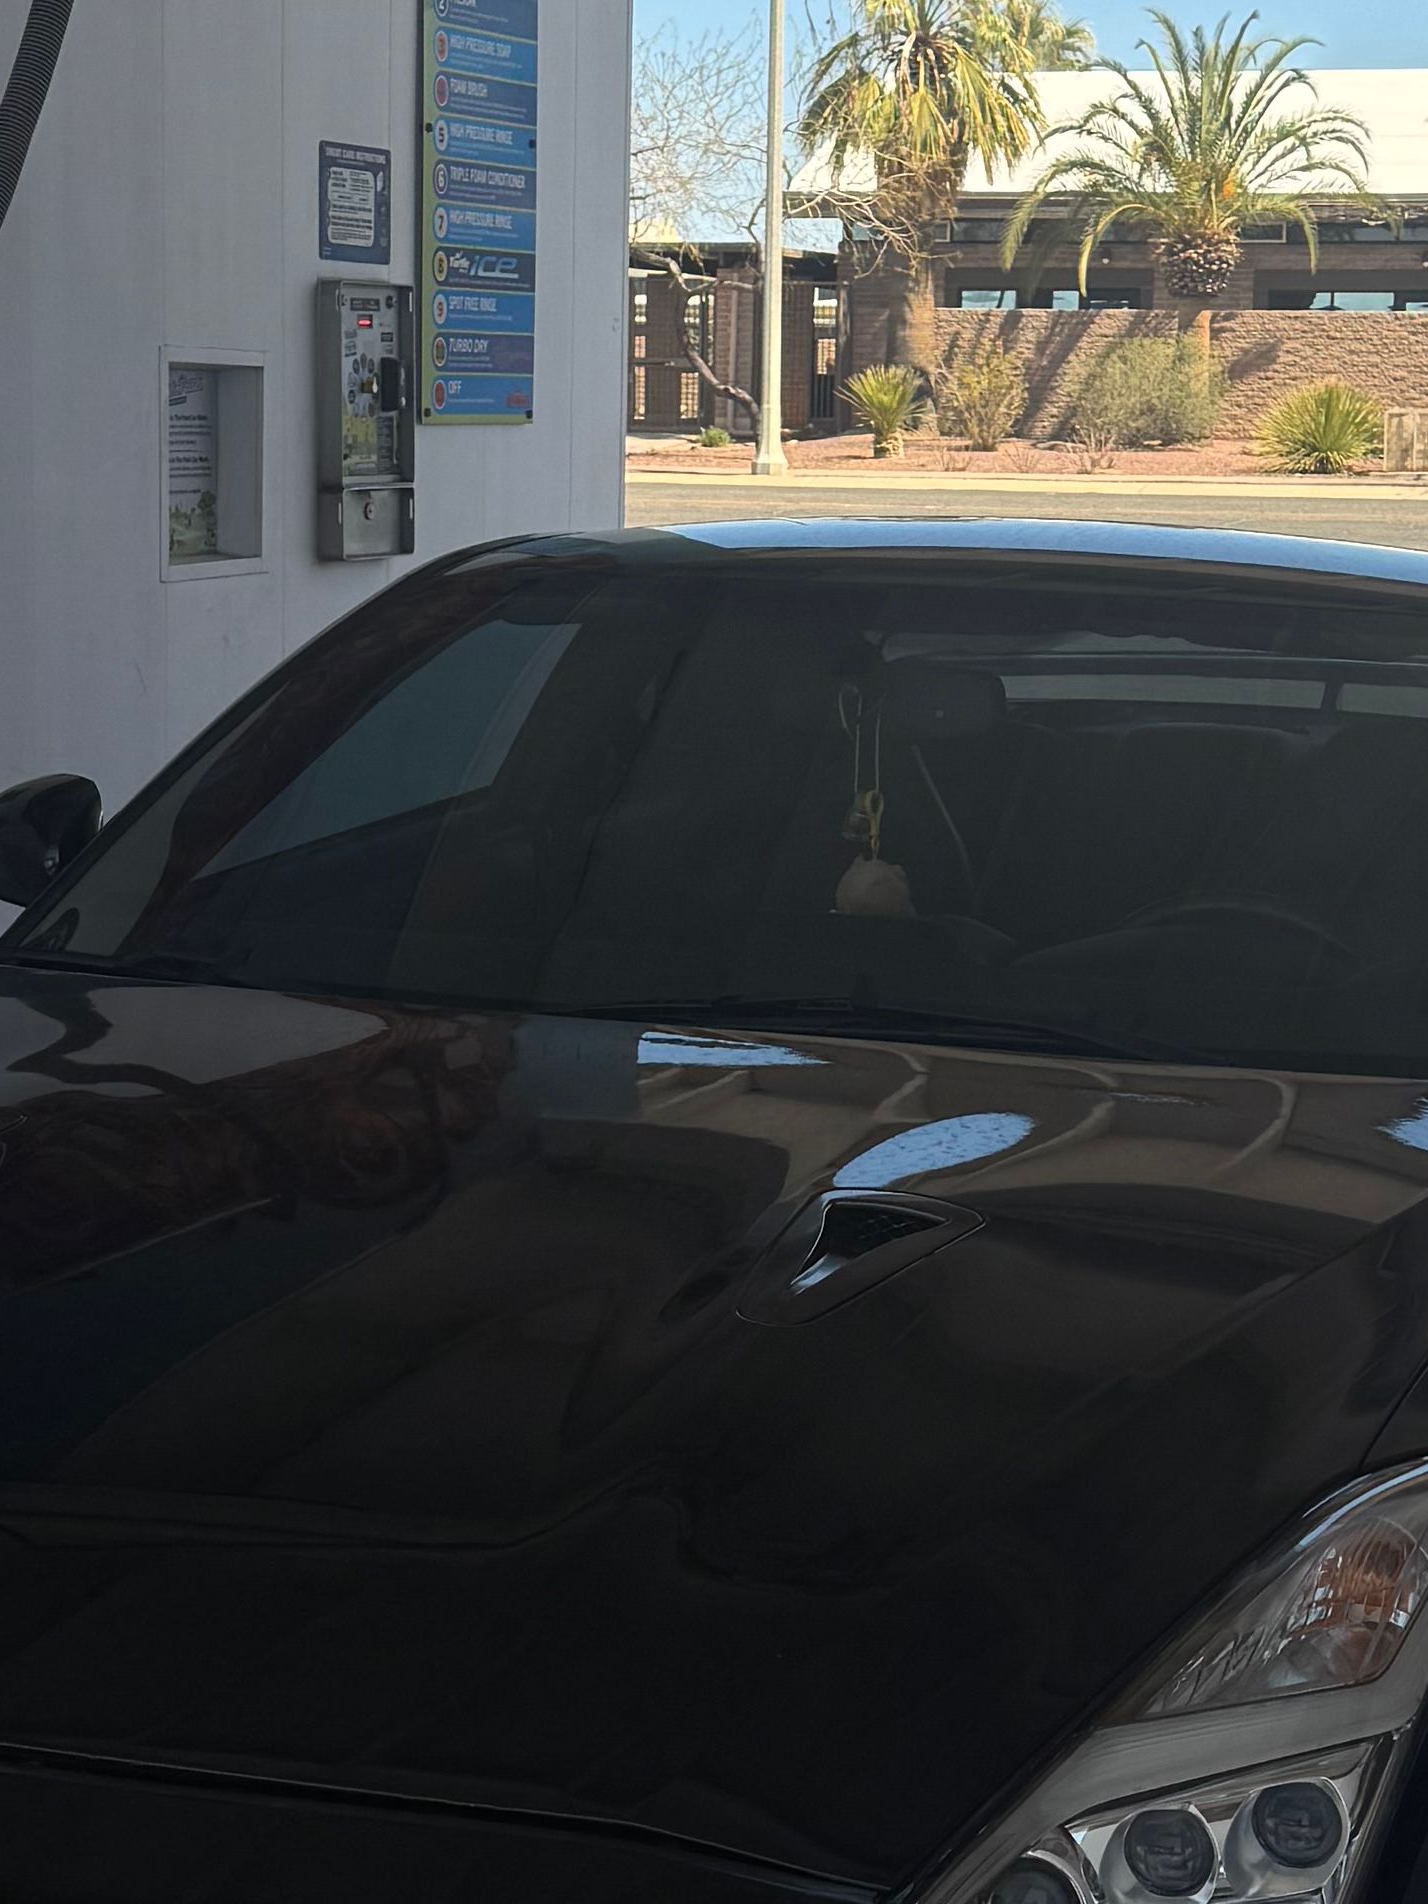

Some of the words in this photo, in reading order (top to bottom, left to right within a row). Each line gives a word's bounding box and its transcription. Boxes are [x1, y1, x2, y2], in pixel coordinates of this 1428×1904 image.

[448, 338, 473, 353] TURBO
[474, 339, 489, 353] DRY
[448, 380, 462, 395] OFF
